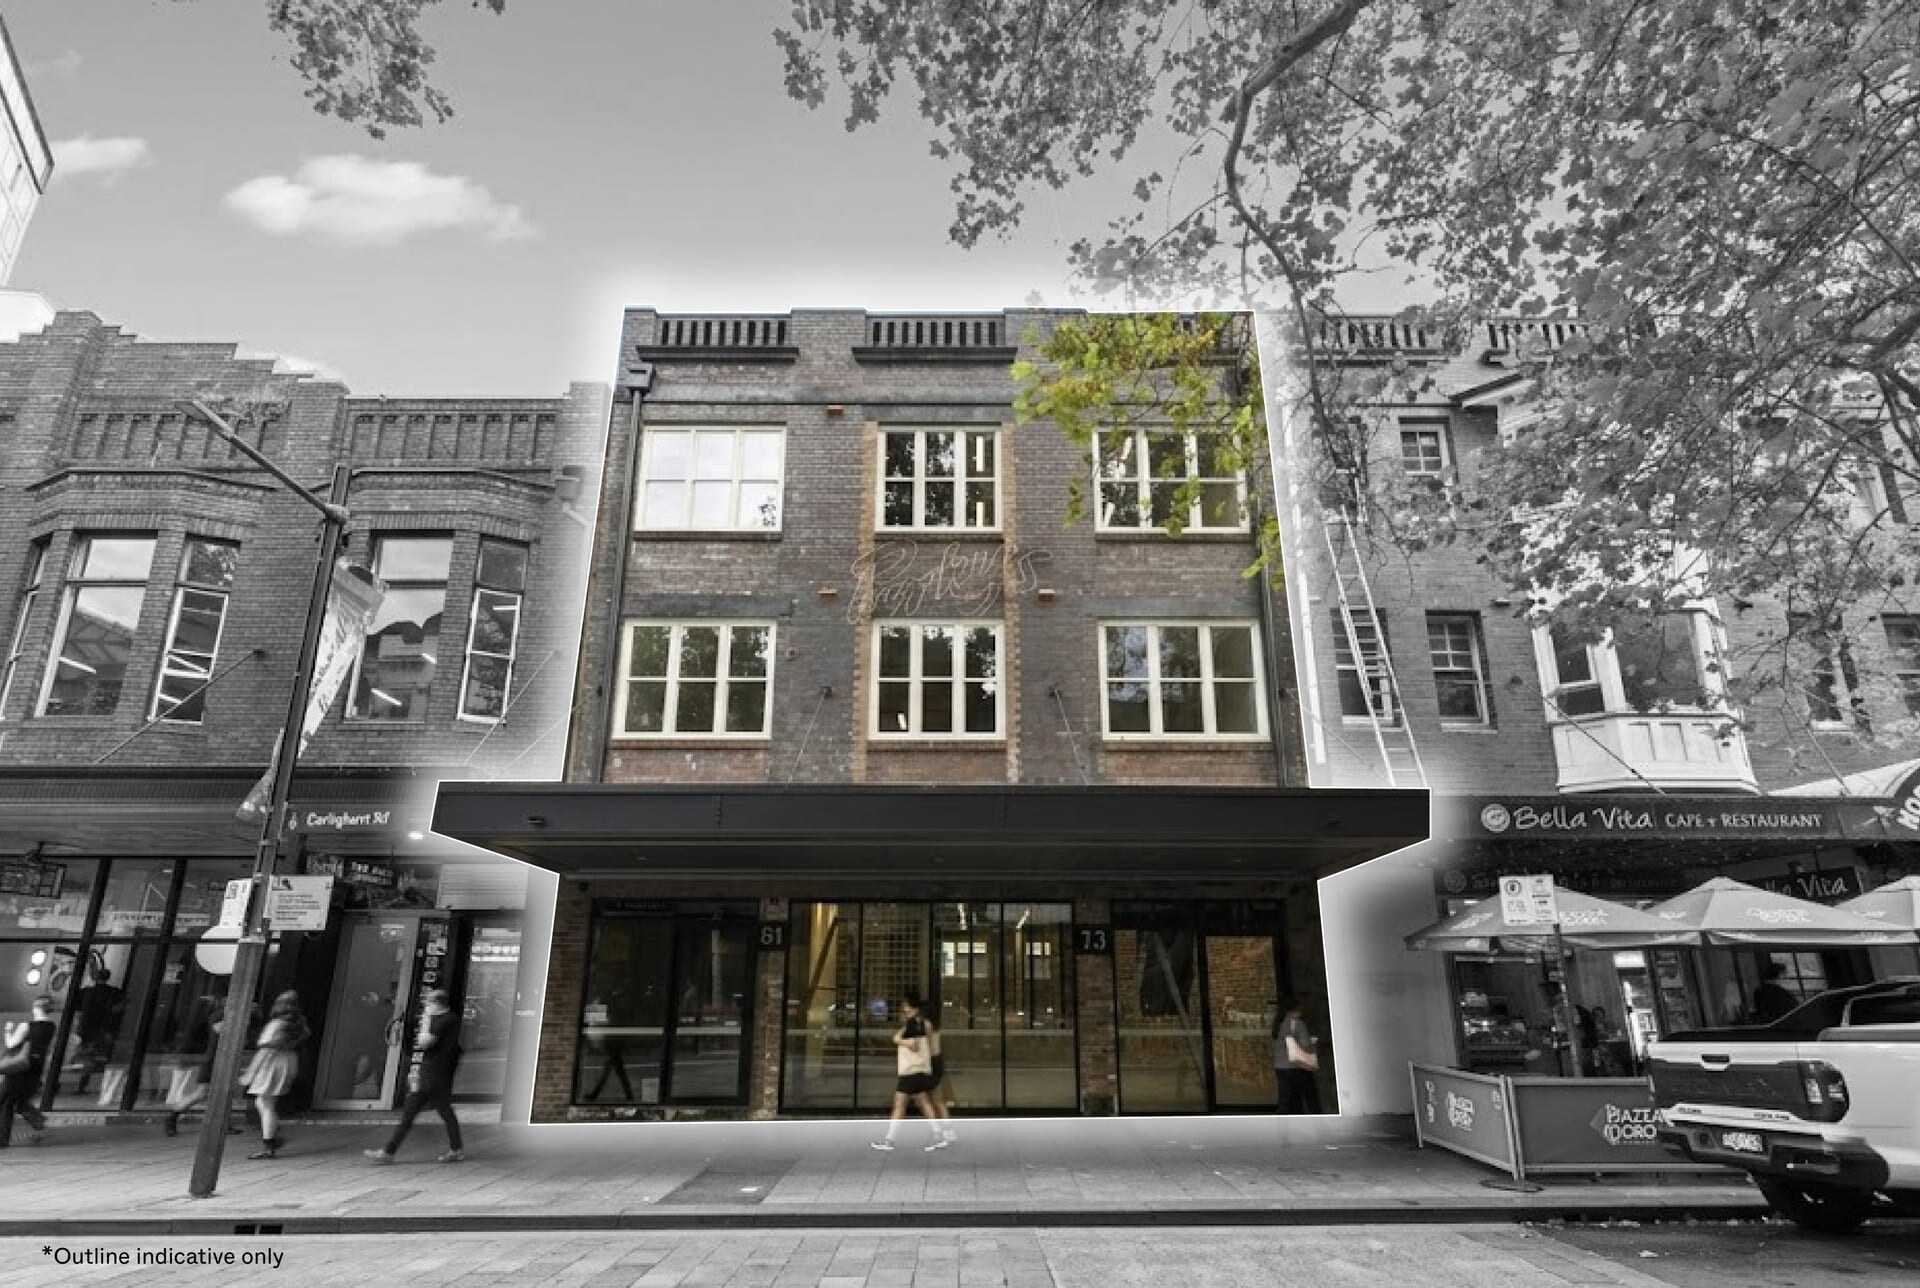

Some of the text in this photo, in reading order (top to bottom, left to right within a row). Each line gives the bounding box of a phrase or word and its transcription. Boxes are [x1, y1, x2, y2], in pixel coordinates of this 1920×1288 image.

[1513, 805, 1588, 830] Bella
[1592, 806, 1654, 830] Vita
[1720, 813, 1823, 828] RESTAURANT
[1080, 929, 1106, 950] 73
